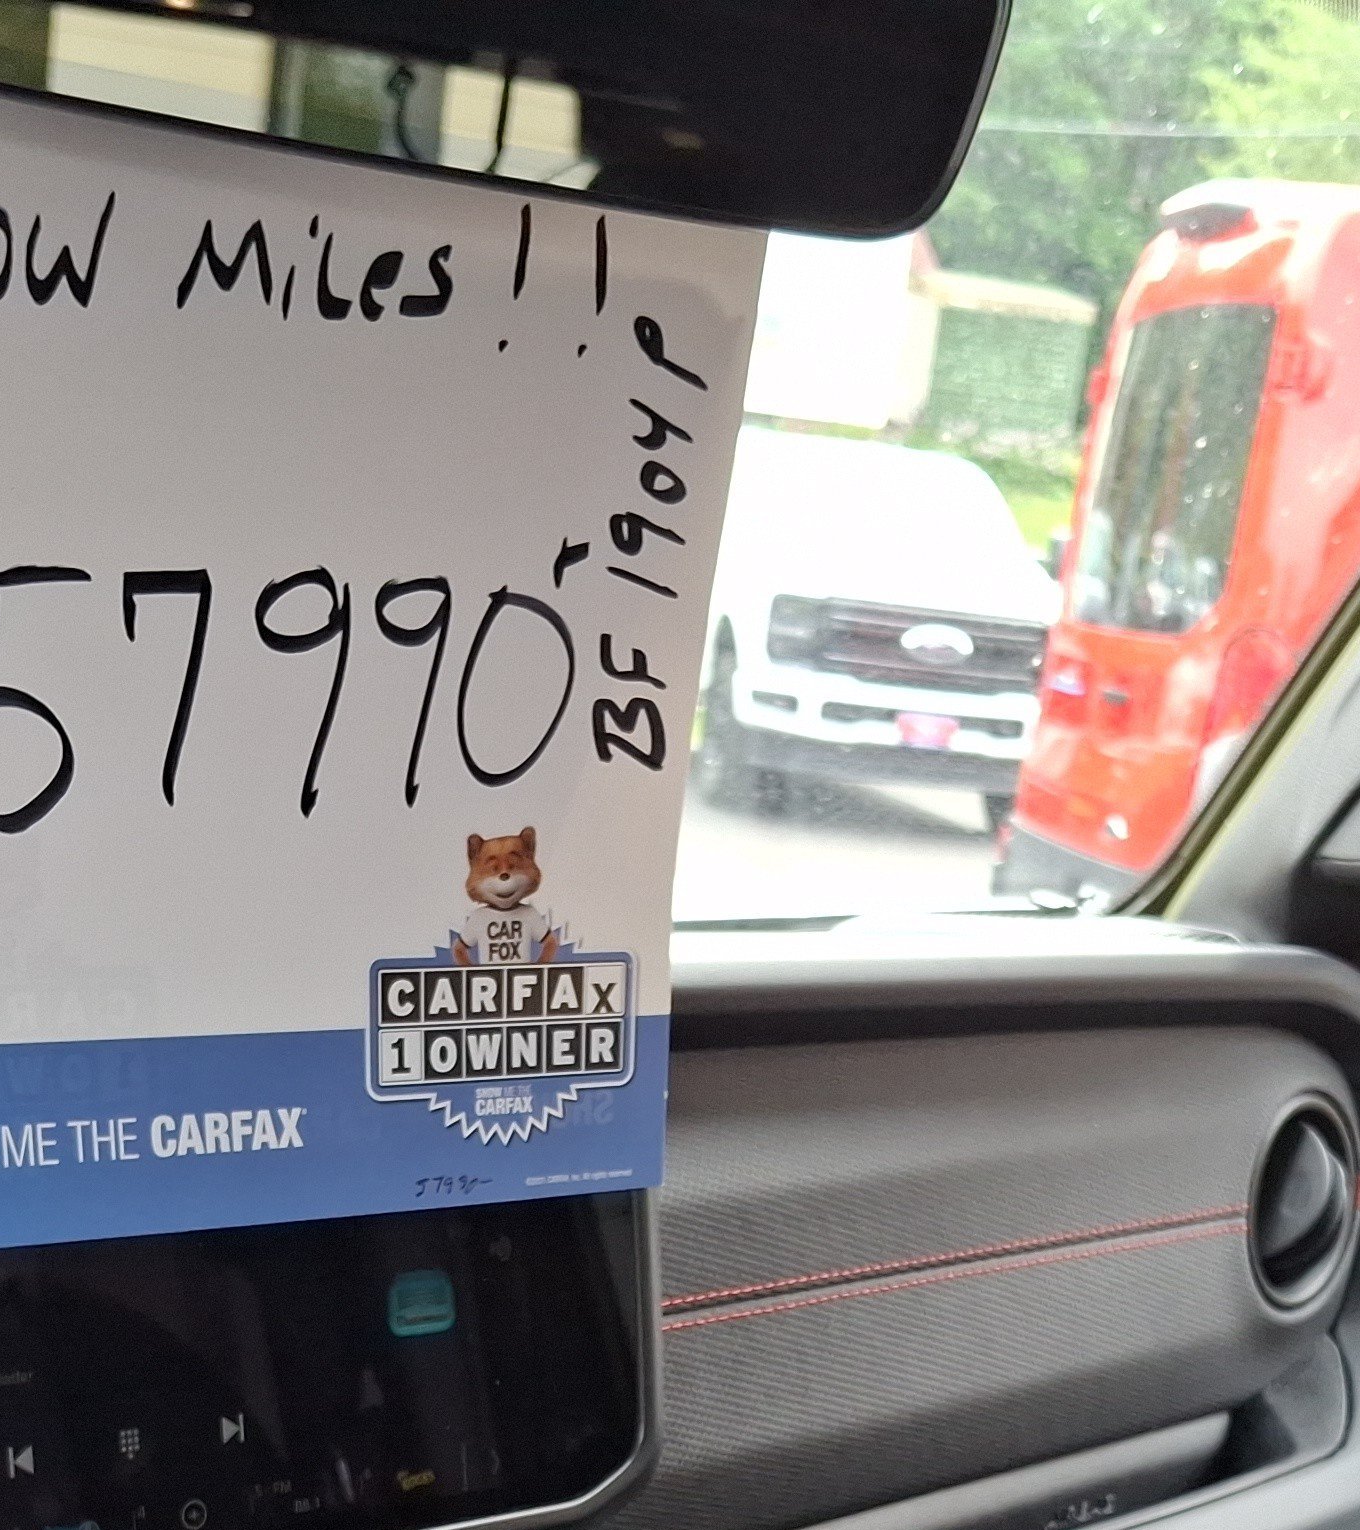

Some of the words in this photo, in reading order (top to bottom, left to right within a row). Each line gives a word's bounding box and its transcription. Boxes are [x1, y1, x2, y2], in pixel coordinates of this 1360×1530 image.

[486, 919, 523, 941] CAR
[488, 941, 522, 961] FOX
[386, 972, 617, 1019] CARFAX
[390, 1038, 413, 1076] 1
[429, 1028, 615, 1074] OWNER
[474, 1095, 533, 1117] CARFAX
[0, 1121, 60, 1168] ME
[67, 1115, 138, 1161] THE
[150, 1108, 304, 1159] CARFAX
